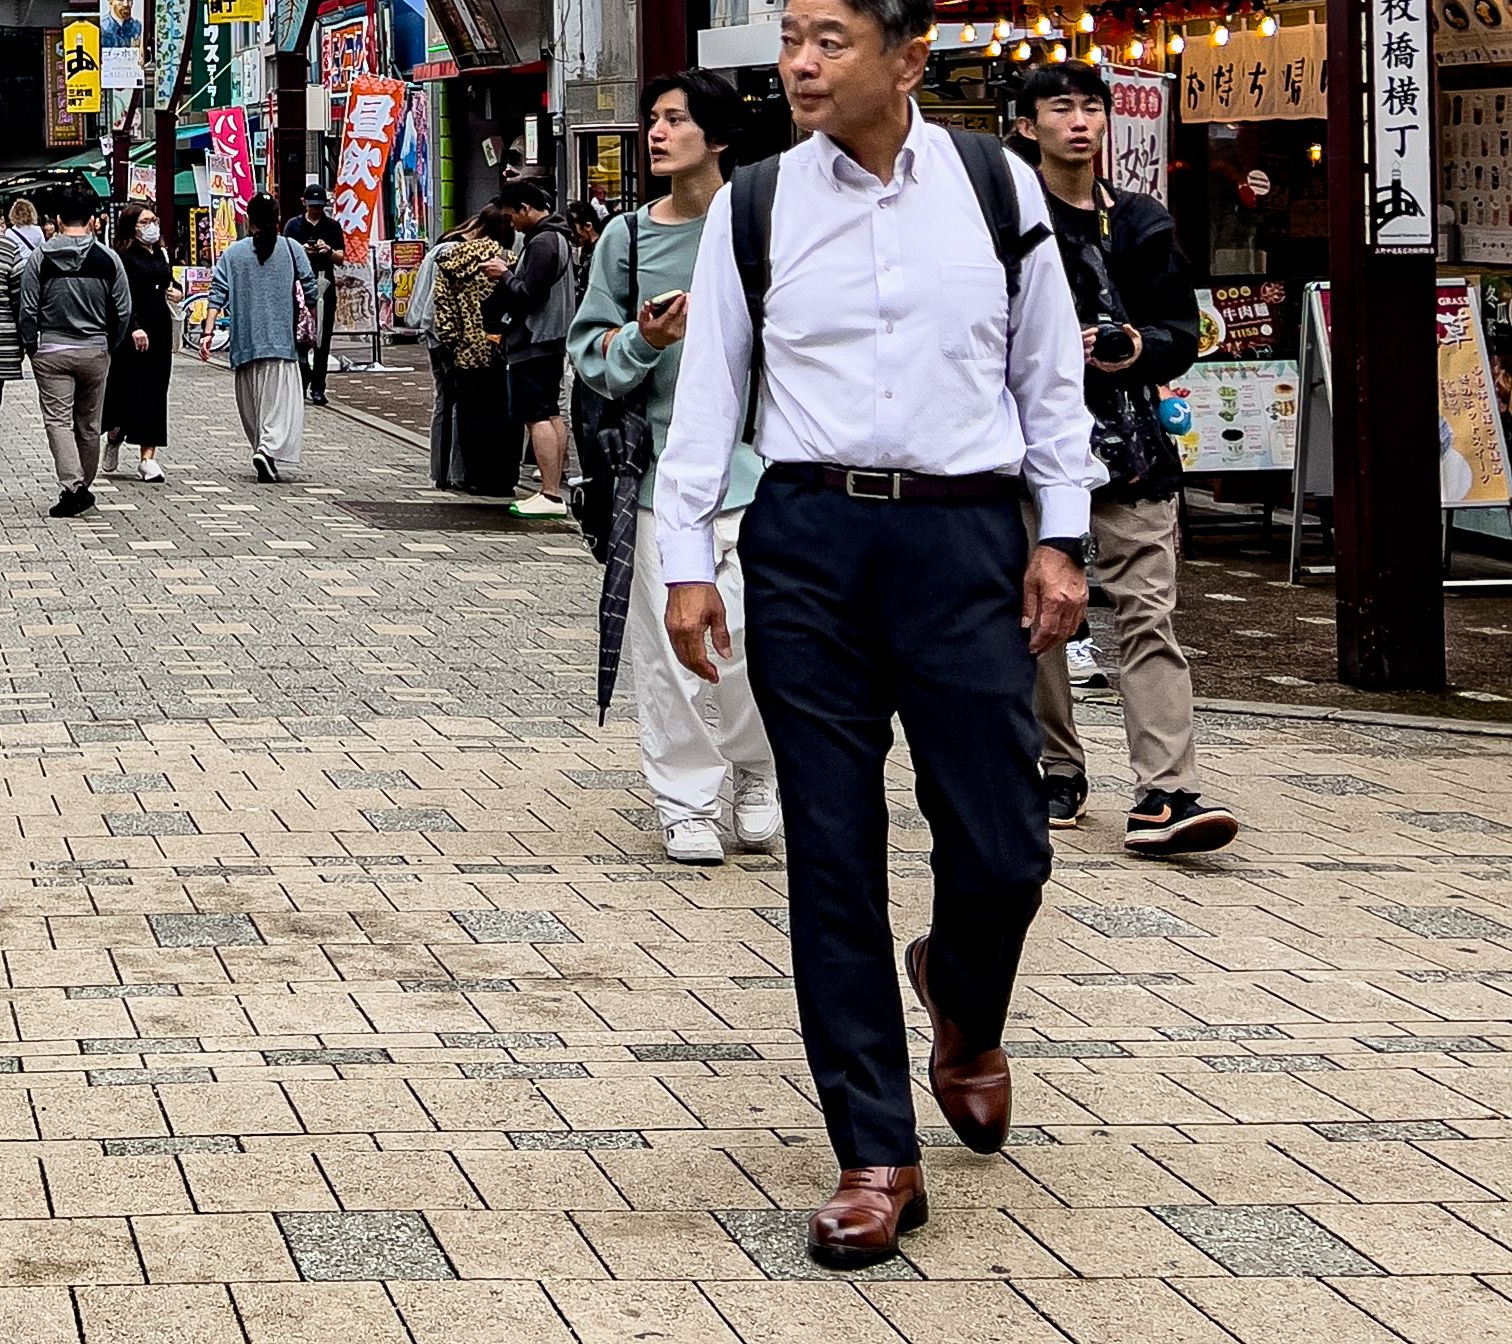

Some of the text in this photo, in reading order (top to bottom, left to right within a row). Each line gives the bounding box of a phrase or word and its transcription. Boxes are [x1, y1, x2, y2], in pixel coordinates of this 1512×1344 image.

[209, 0, 237, 14] 横丁
[335, 93, 396, 235] 昼飲み
